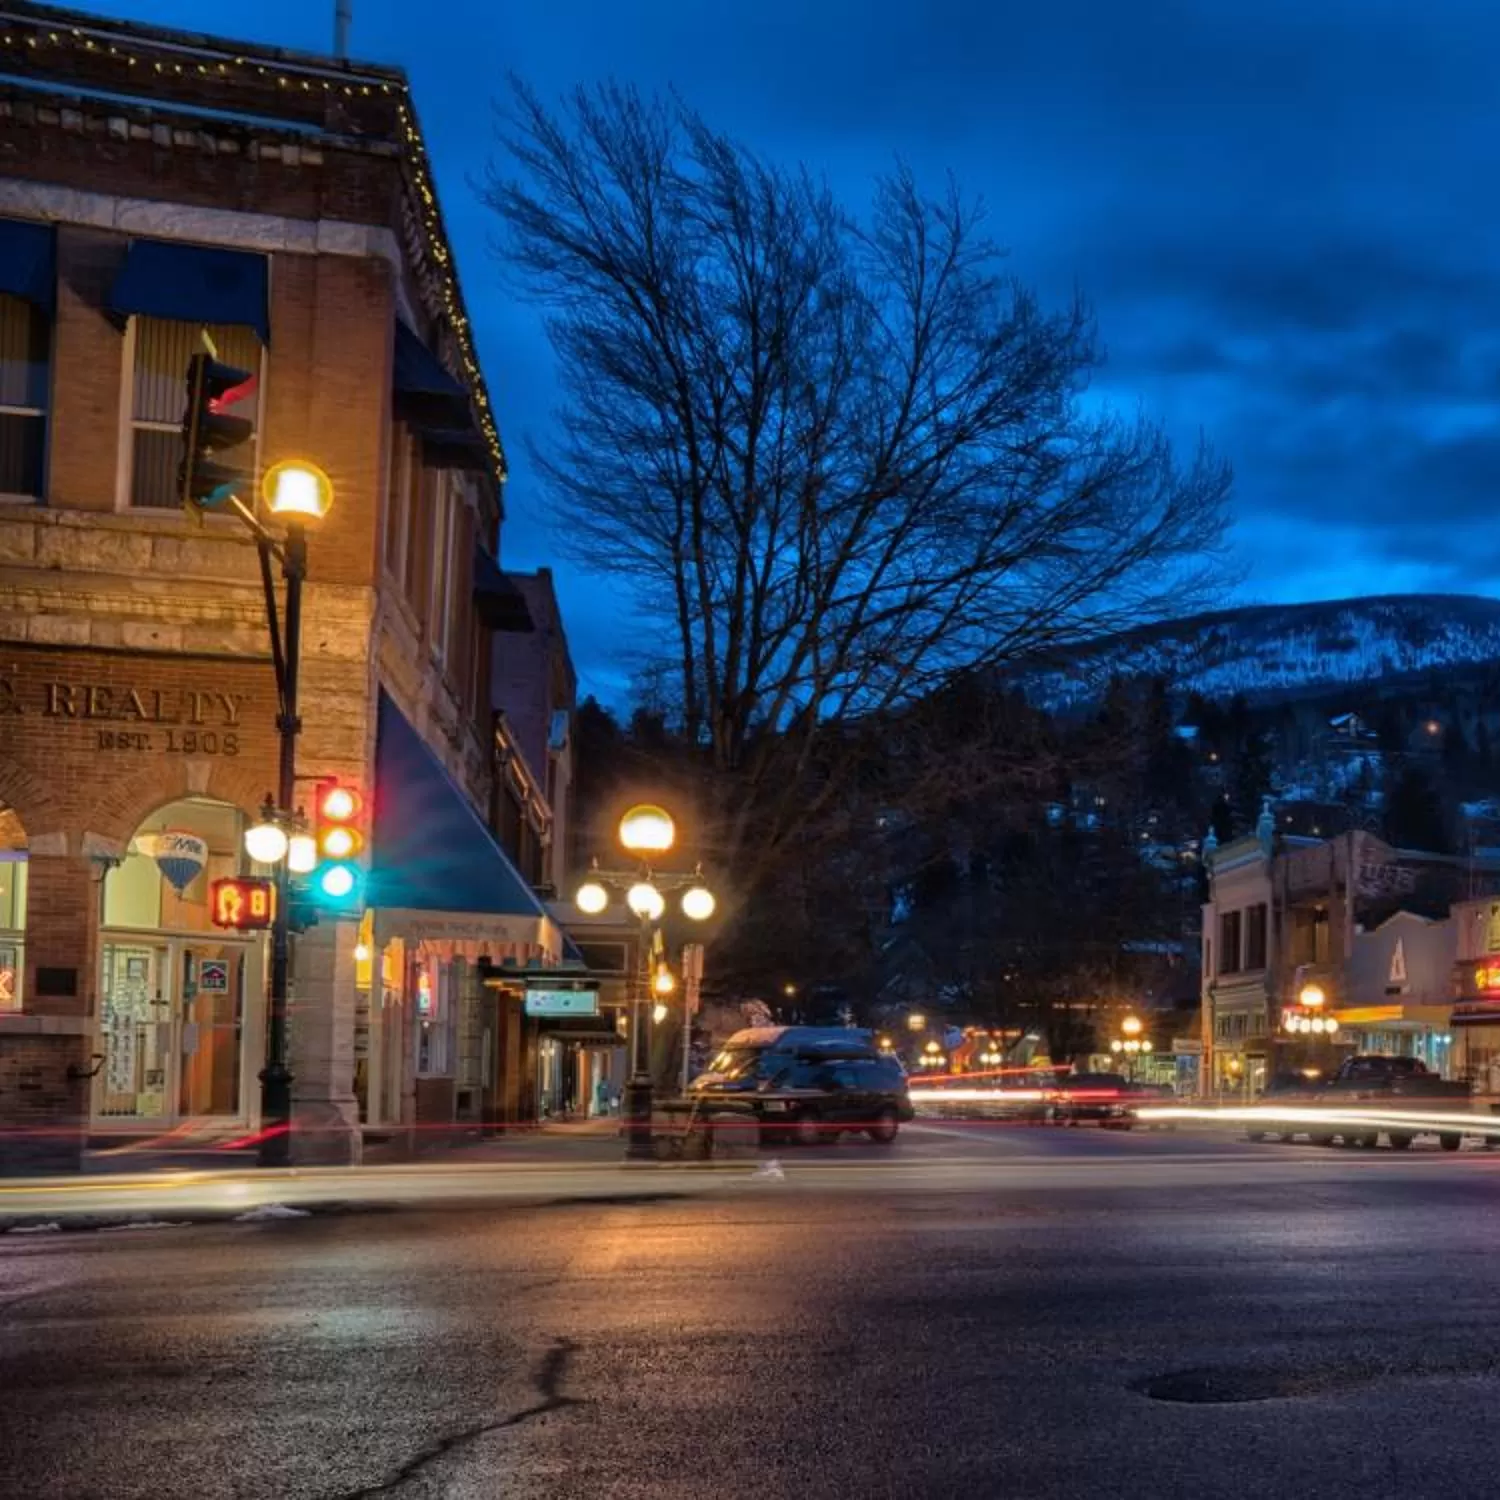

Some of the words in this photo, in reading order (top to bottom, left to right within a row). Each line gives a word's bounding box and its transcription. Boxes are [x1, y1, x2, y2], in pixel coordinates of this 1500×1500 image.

[42, 682, 250, 727] REALTY
[98, 731, 153, 751] EST.
[165, 731, 241, 757] 1908
